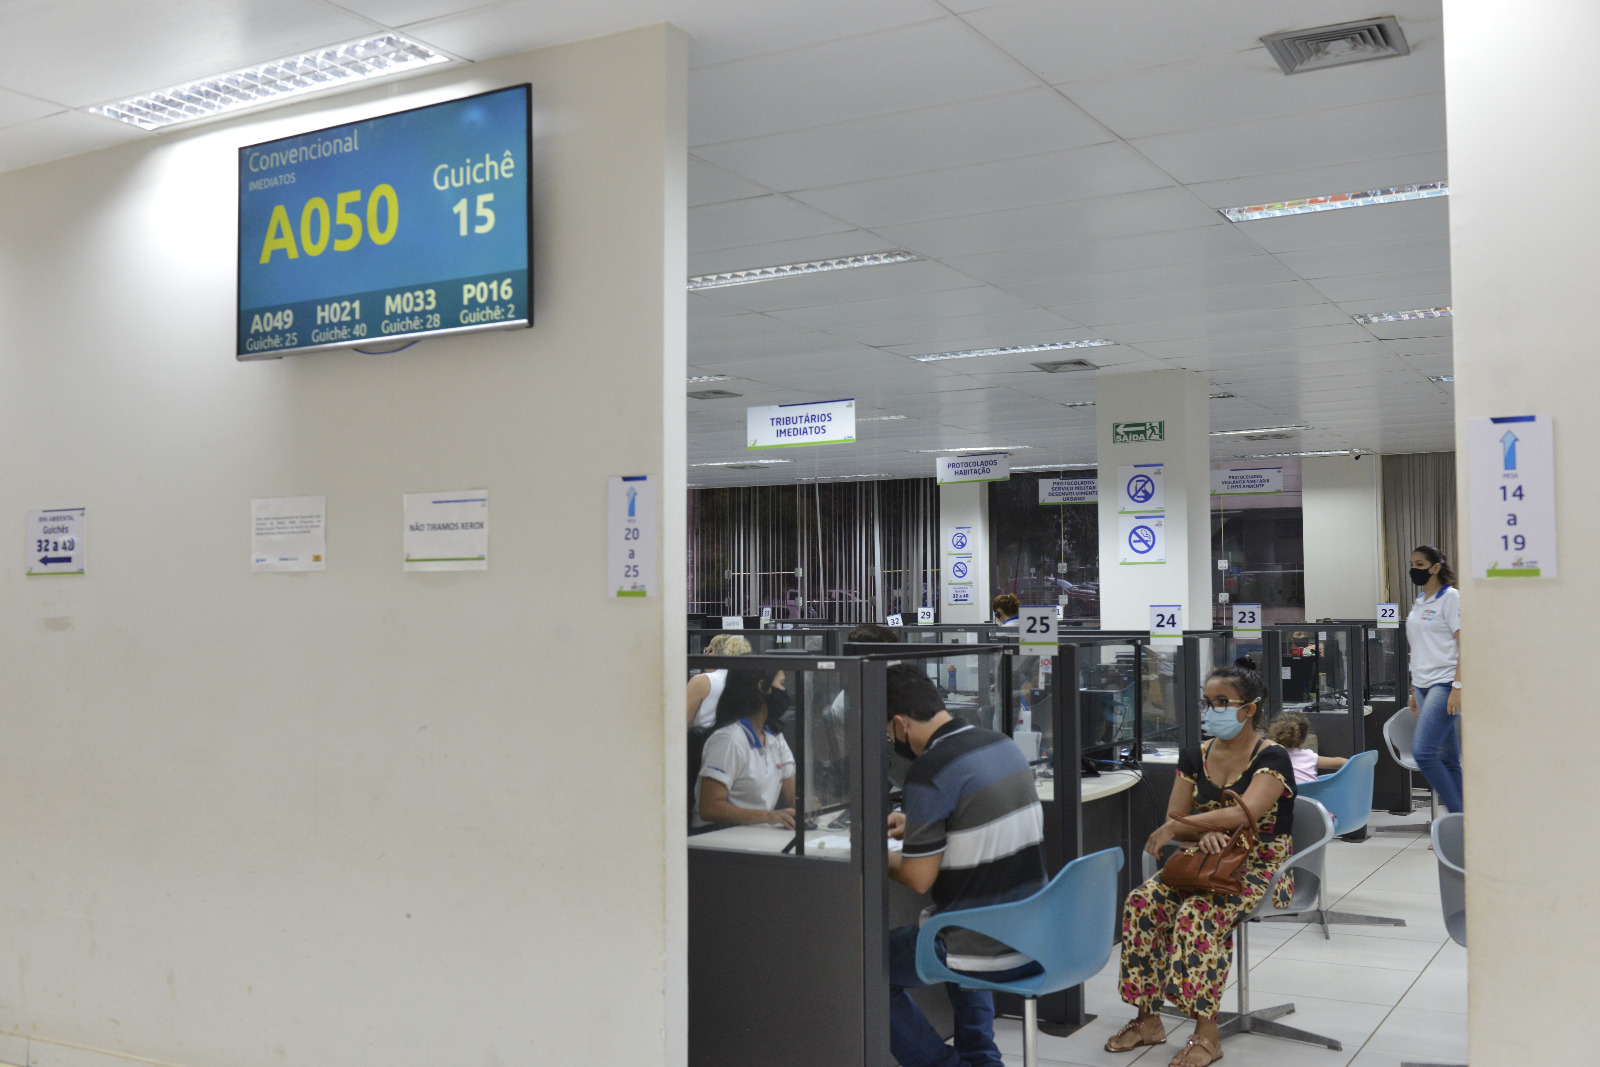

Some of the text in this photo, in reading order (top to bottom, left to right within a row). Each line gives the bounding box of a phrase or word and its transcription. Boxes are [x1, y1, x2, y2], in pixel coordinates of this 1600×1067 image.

[250, 130, 359, 172] Convencional
[433, 150, 515, 190] Guichê
[248, 172, 296, 191] IMEDIATOS
[452, 192, 496, 236] 15
[259, 184, 399, 264] A050
[463, 278, 513, 305] P016
[385, 289, 436, 315] M033
[316, 300, 360, 324] H021
[460, 304, 515, 324] Guichê: 2
[250, 310, 294, 334] A049
[381, 314, 440, 334] Guichê: 28
[284, 332, 298, 346] 25
[312, 323, 367, 342] Guichê: 40
[770, 413, 832, 426] TRIBUTÁRIOS
[776, 426, 826, 438] IMEDIATOS
[1116, 433, 1146, 442] SAÍDA
[948, 460, 998, 469] PROTOCOLADOS
[954, 467, 990, 476] HABITAÇÃO
[1500, 485, 1524, 501] 14
[409, 521, 484, 532] NÃO TIRAMOS XEROX
[1506, 513, 1518, 526] a
[43, 525, 69, 534] Guichês
[624, 528, 640, 540] 20
[37, 539, 50, 552] 32
[52, 541, 58, 552] a
[1501, 534, 1526, 551] 19
[628, 549, 635, 559] a
[624, 565, 639, 578] 25
[1238, 611, 1256, 623] 23
[1381, 609, 1394, 617] 22
[1026, 616, 1050, 634] 25
[1156, 614, 1176, 628] 24
